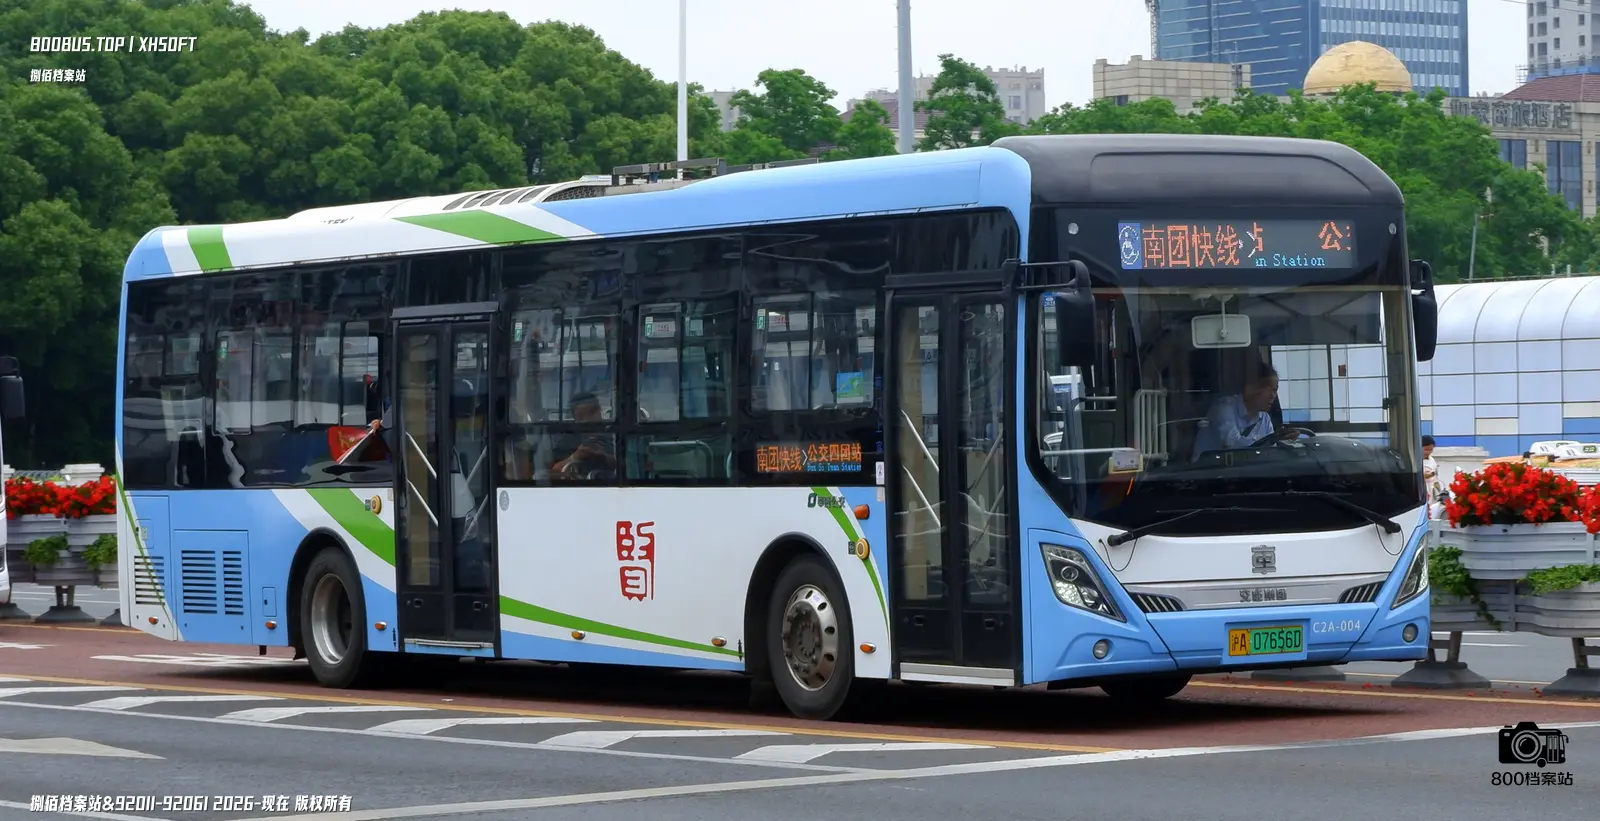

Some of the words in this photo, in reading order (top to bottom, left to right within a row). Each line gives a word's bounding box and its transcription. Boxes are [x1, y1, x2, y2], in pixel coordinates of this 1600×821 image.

[1142, 224, 1240, 268] 南团快线
[1273, 253, 1326, 267] Station
[757, 445, 802, 472] 南团快线
[807, 443, 862, 462] 公交四团站
[1312, 620, 1361, 633] C2A-004
[1253, 630, 1302, 651] 07656D
